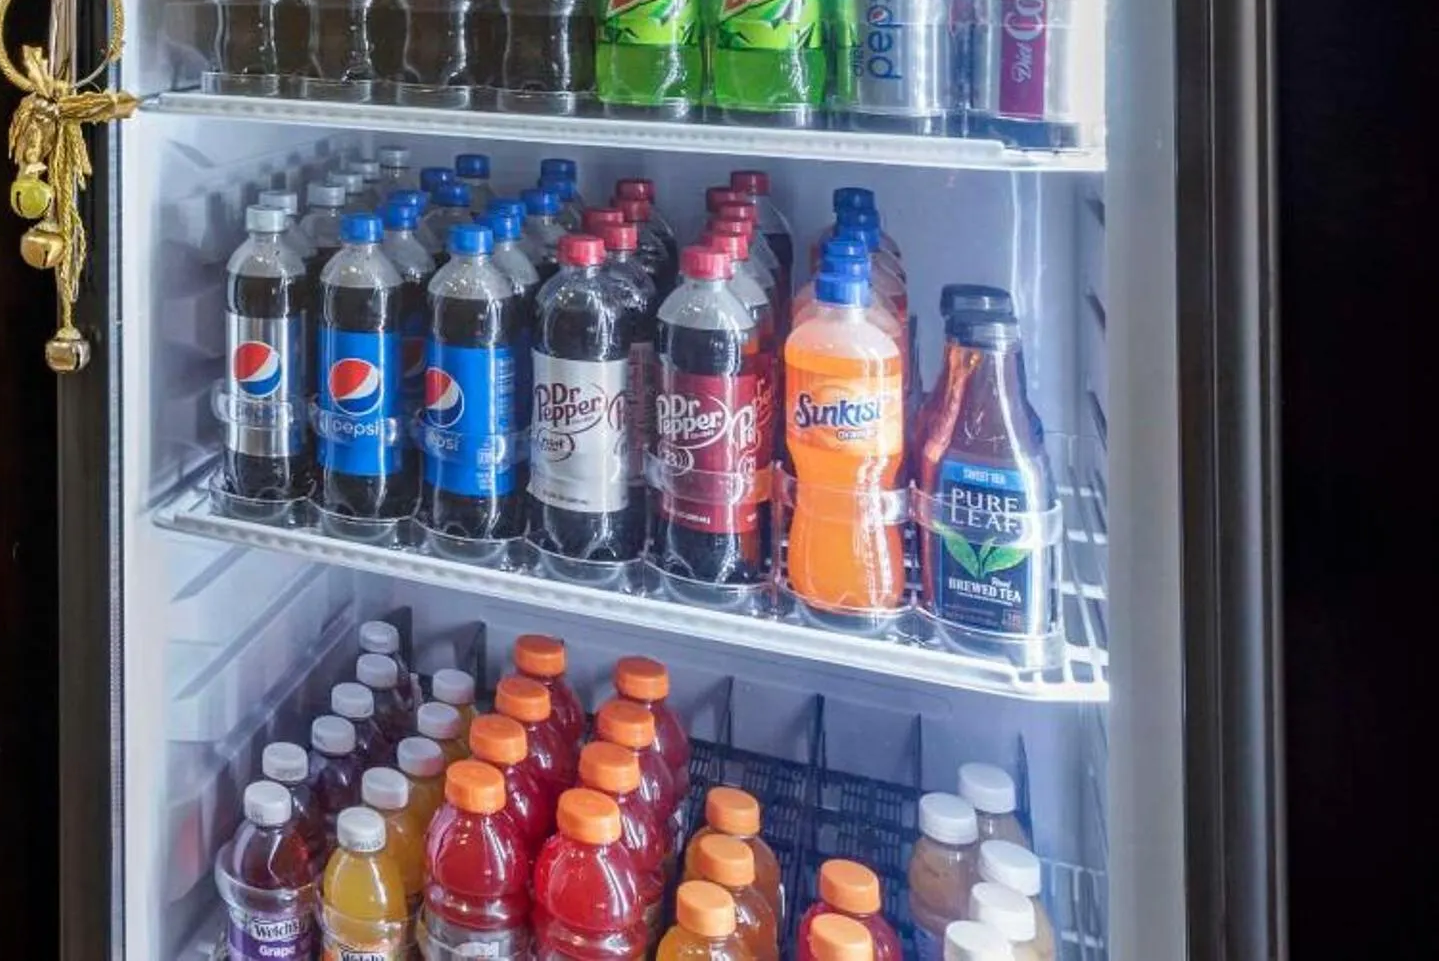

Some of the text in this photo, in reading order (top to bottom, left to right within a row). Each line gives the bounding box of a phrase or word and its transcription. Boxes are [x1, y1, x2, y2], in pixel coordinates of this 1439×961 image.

[1012, 41, 1033, 83] Diet
[534, 383, 602, 428] Pepper
[551, 382, 581, 405] Dr
[670, 393, 701, 418] Dr
[332, 419, 381, 438] pepsi
[655, 394, 723, 441] Pepper
[951, 487, 1019, 514] PURE
[951, 508, 1019, 533] LEAF
[948, 577, 997, 598] BREWED
[1000, 588, 1022, 604] TEA
[259, 944, 296, 958] Grape
